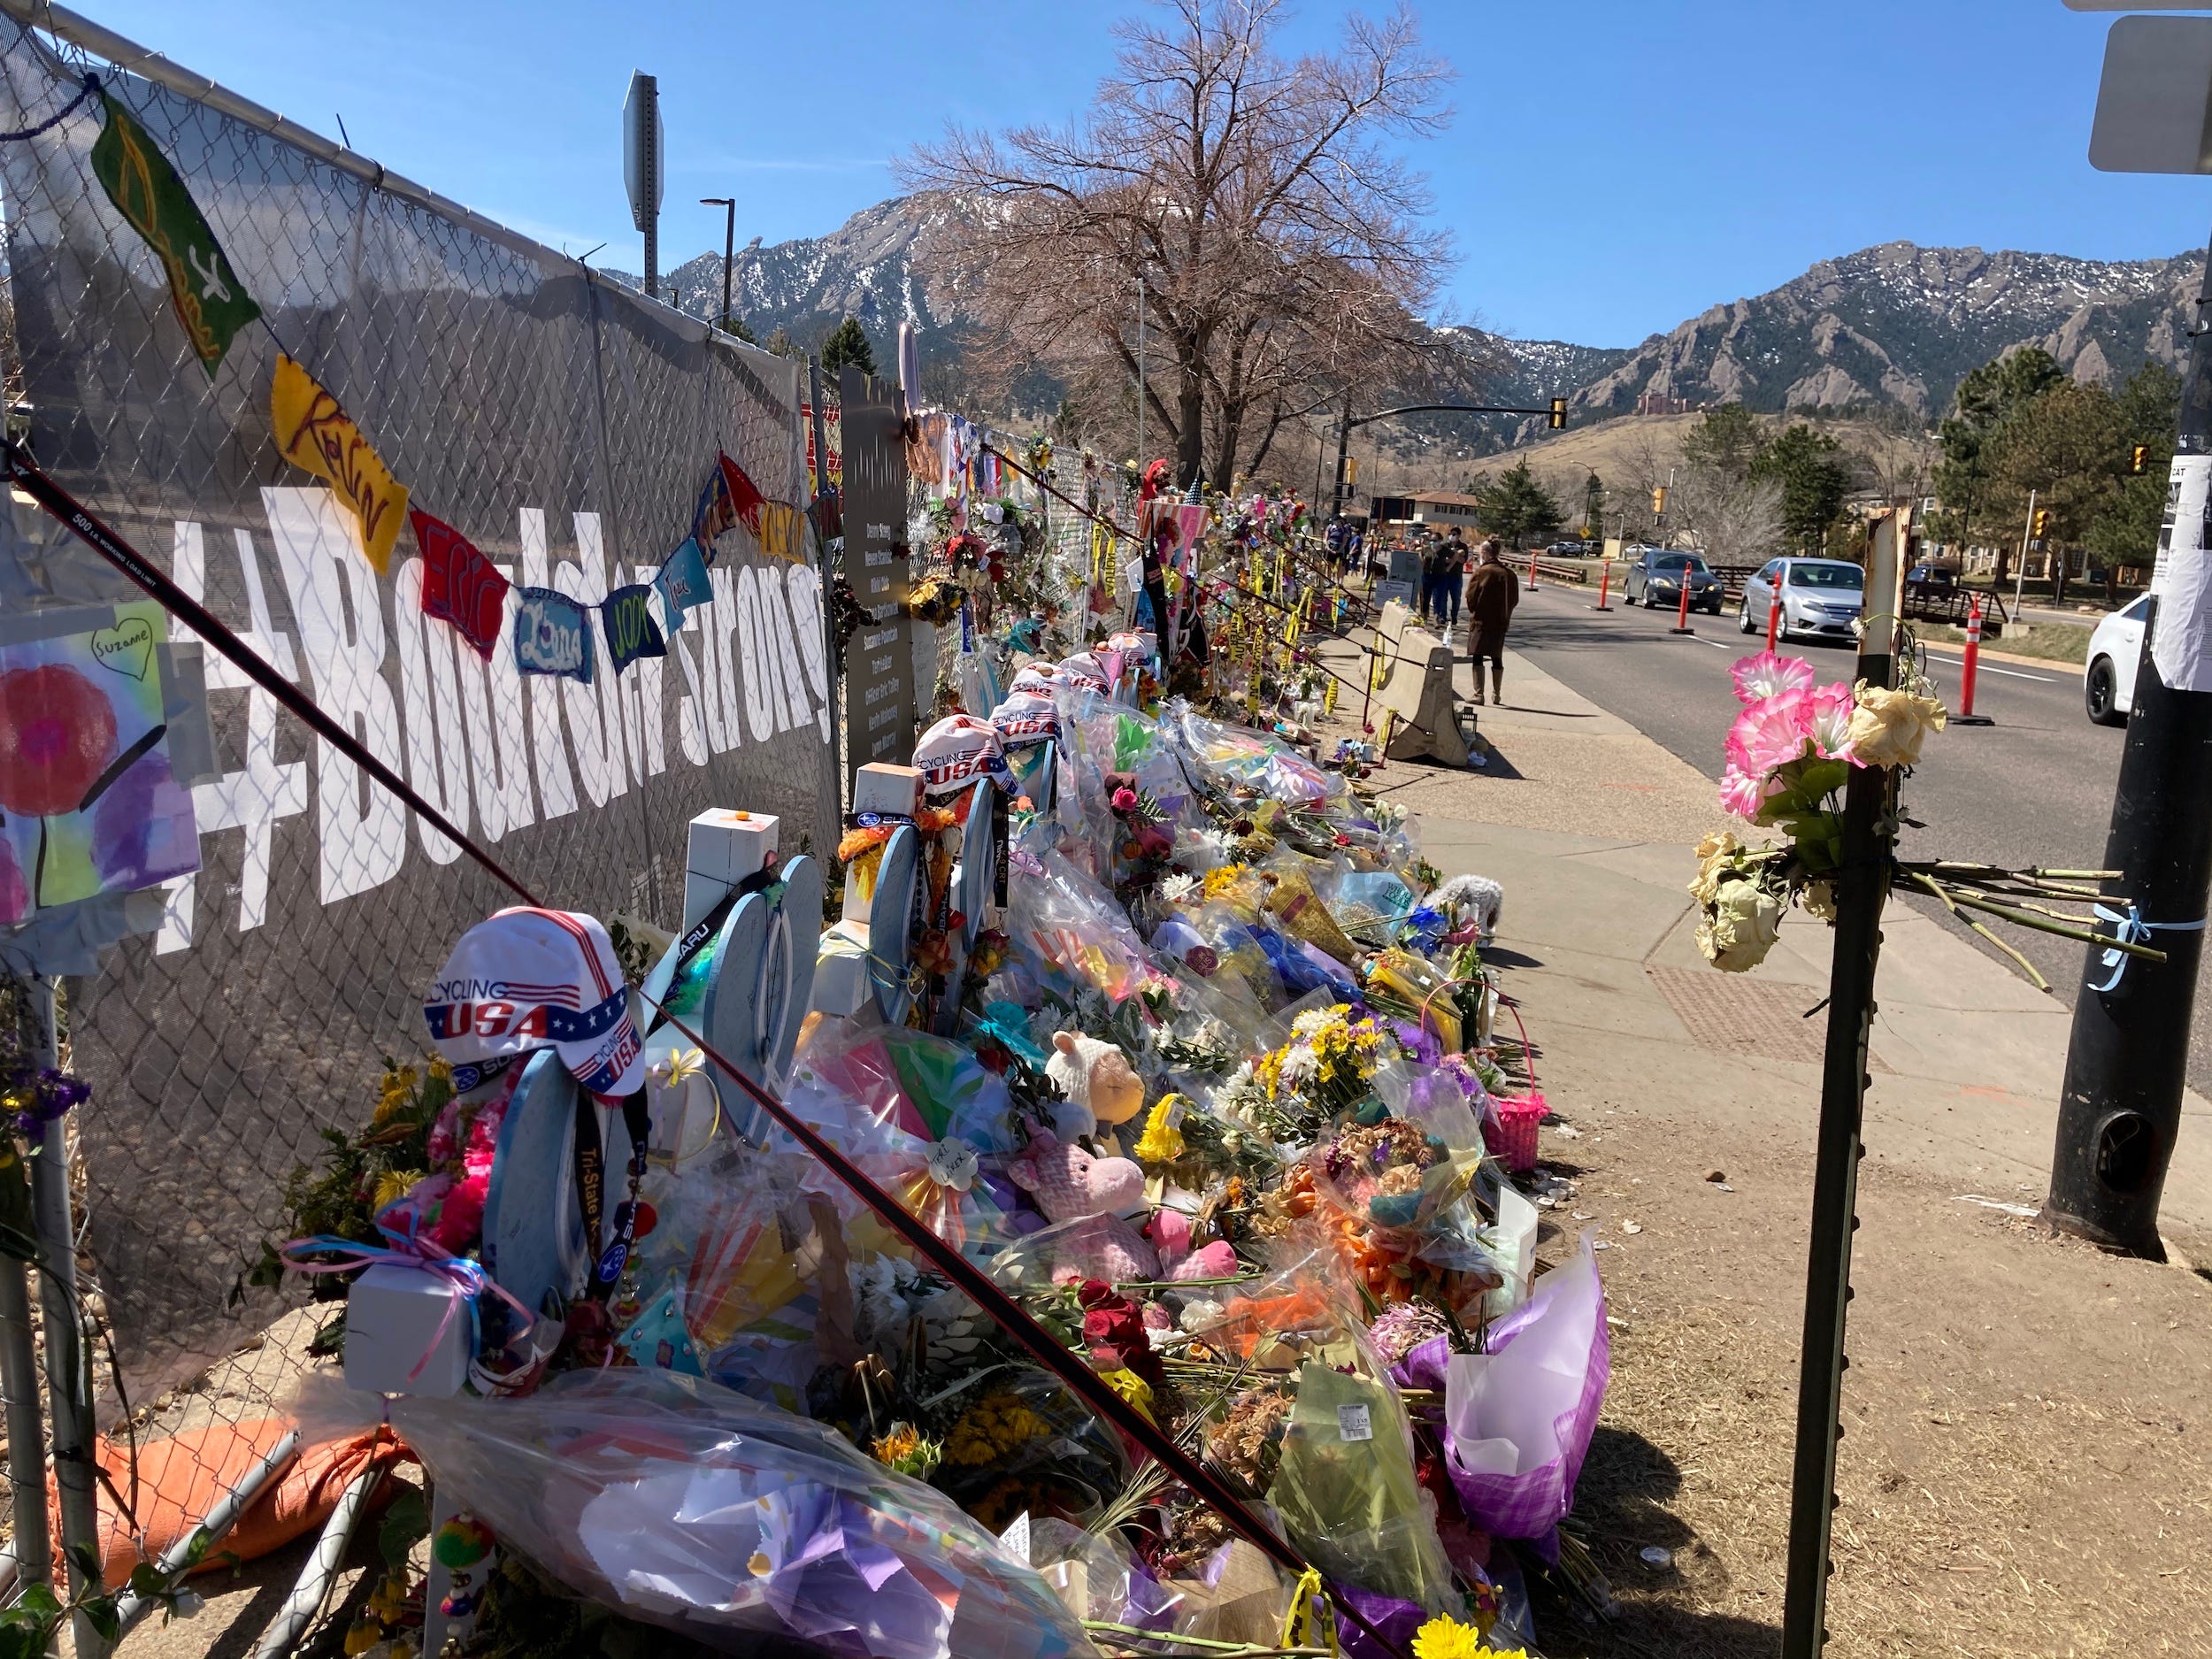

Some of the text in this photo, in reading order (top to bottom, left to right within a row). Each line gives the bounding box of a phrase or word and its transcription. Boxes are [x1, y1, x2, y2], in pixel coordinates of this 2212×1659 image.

[72, 512, 92, 532] 500
[100, 538, 127, 563] WORKING
[126, 560, 142, 578] LOAD
[142, 572, 157, 588] LIMIT
[96, 629, 149, 657] Suzanne
[864, 687, 879, 706] Officer
[998, 711, 1036, 725] CYCLING
[1003, 720, 1055, 737] USA
[919, 751, 966, 771] CYCLING
[931, 757, 990, 786] USA
[430, 979, 510, 1002] CYCLING
[444, 1002, 548, 1039] USA
[594, 1032, 621, 1066] CYCLING
[608, 1034, 642, 1082] USA
[581, 1148, 600, 1215] Tri-State
